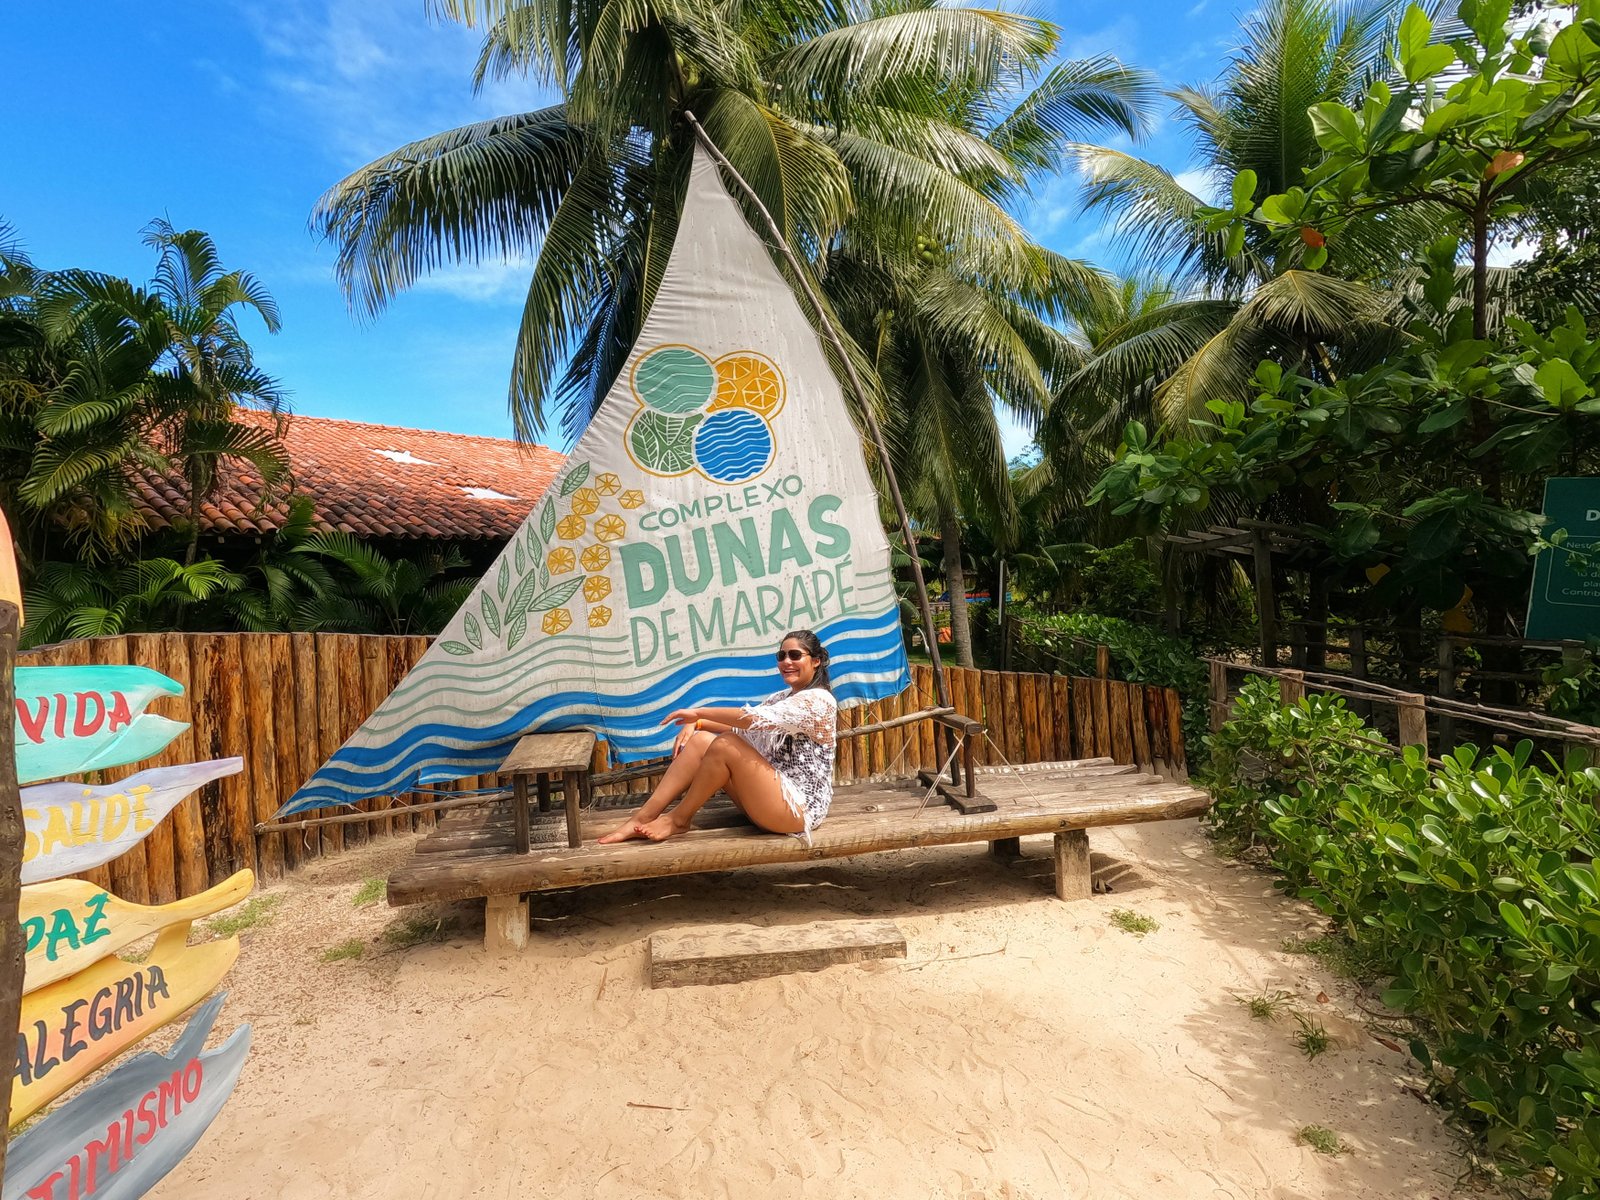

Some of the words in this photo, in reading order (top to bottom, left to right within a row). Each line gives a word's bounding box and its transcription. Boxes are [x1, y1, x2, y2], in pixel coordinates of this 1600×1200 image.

[639, 475, 803, 532] COMPLEXO
[619, 494, 851, 609] DUNAS
[630, 608, 683, 667] DE
[687, 554, 859, 652] MARAPÉ
[15, 691, 133, 744] VIDA
[21, 785, 155, 863] SAÚDE
[21, 891, 111, 961] PAZ
[12, 965, 170, 1087] ALEGRIA
